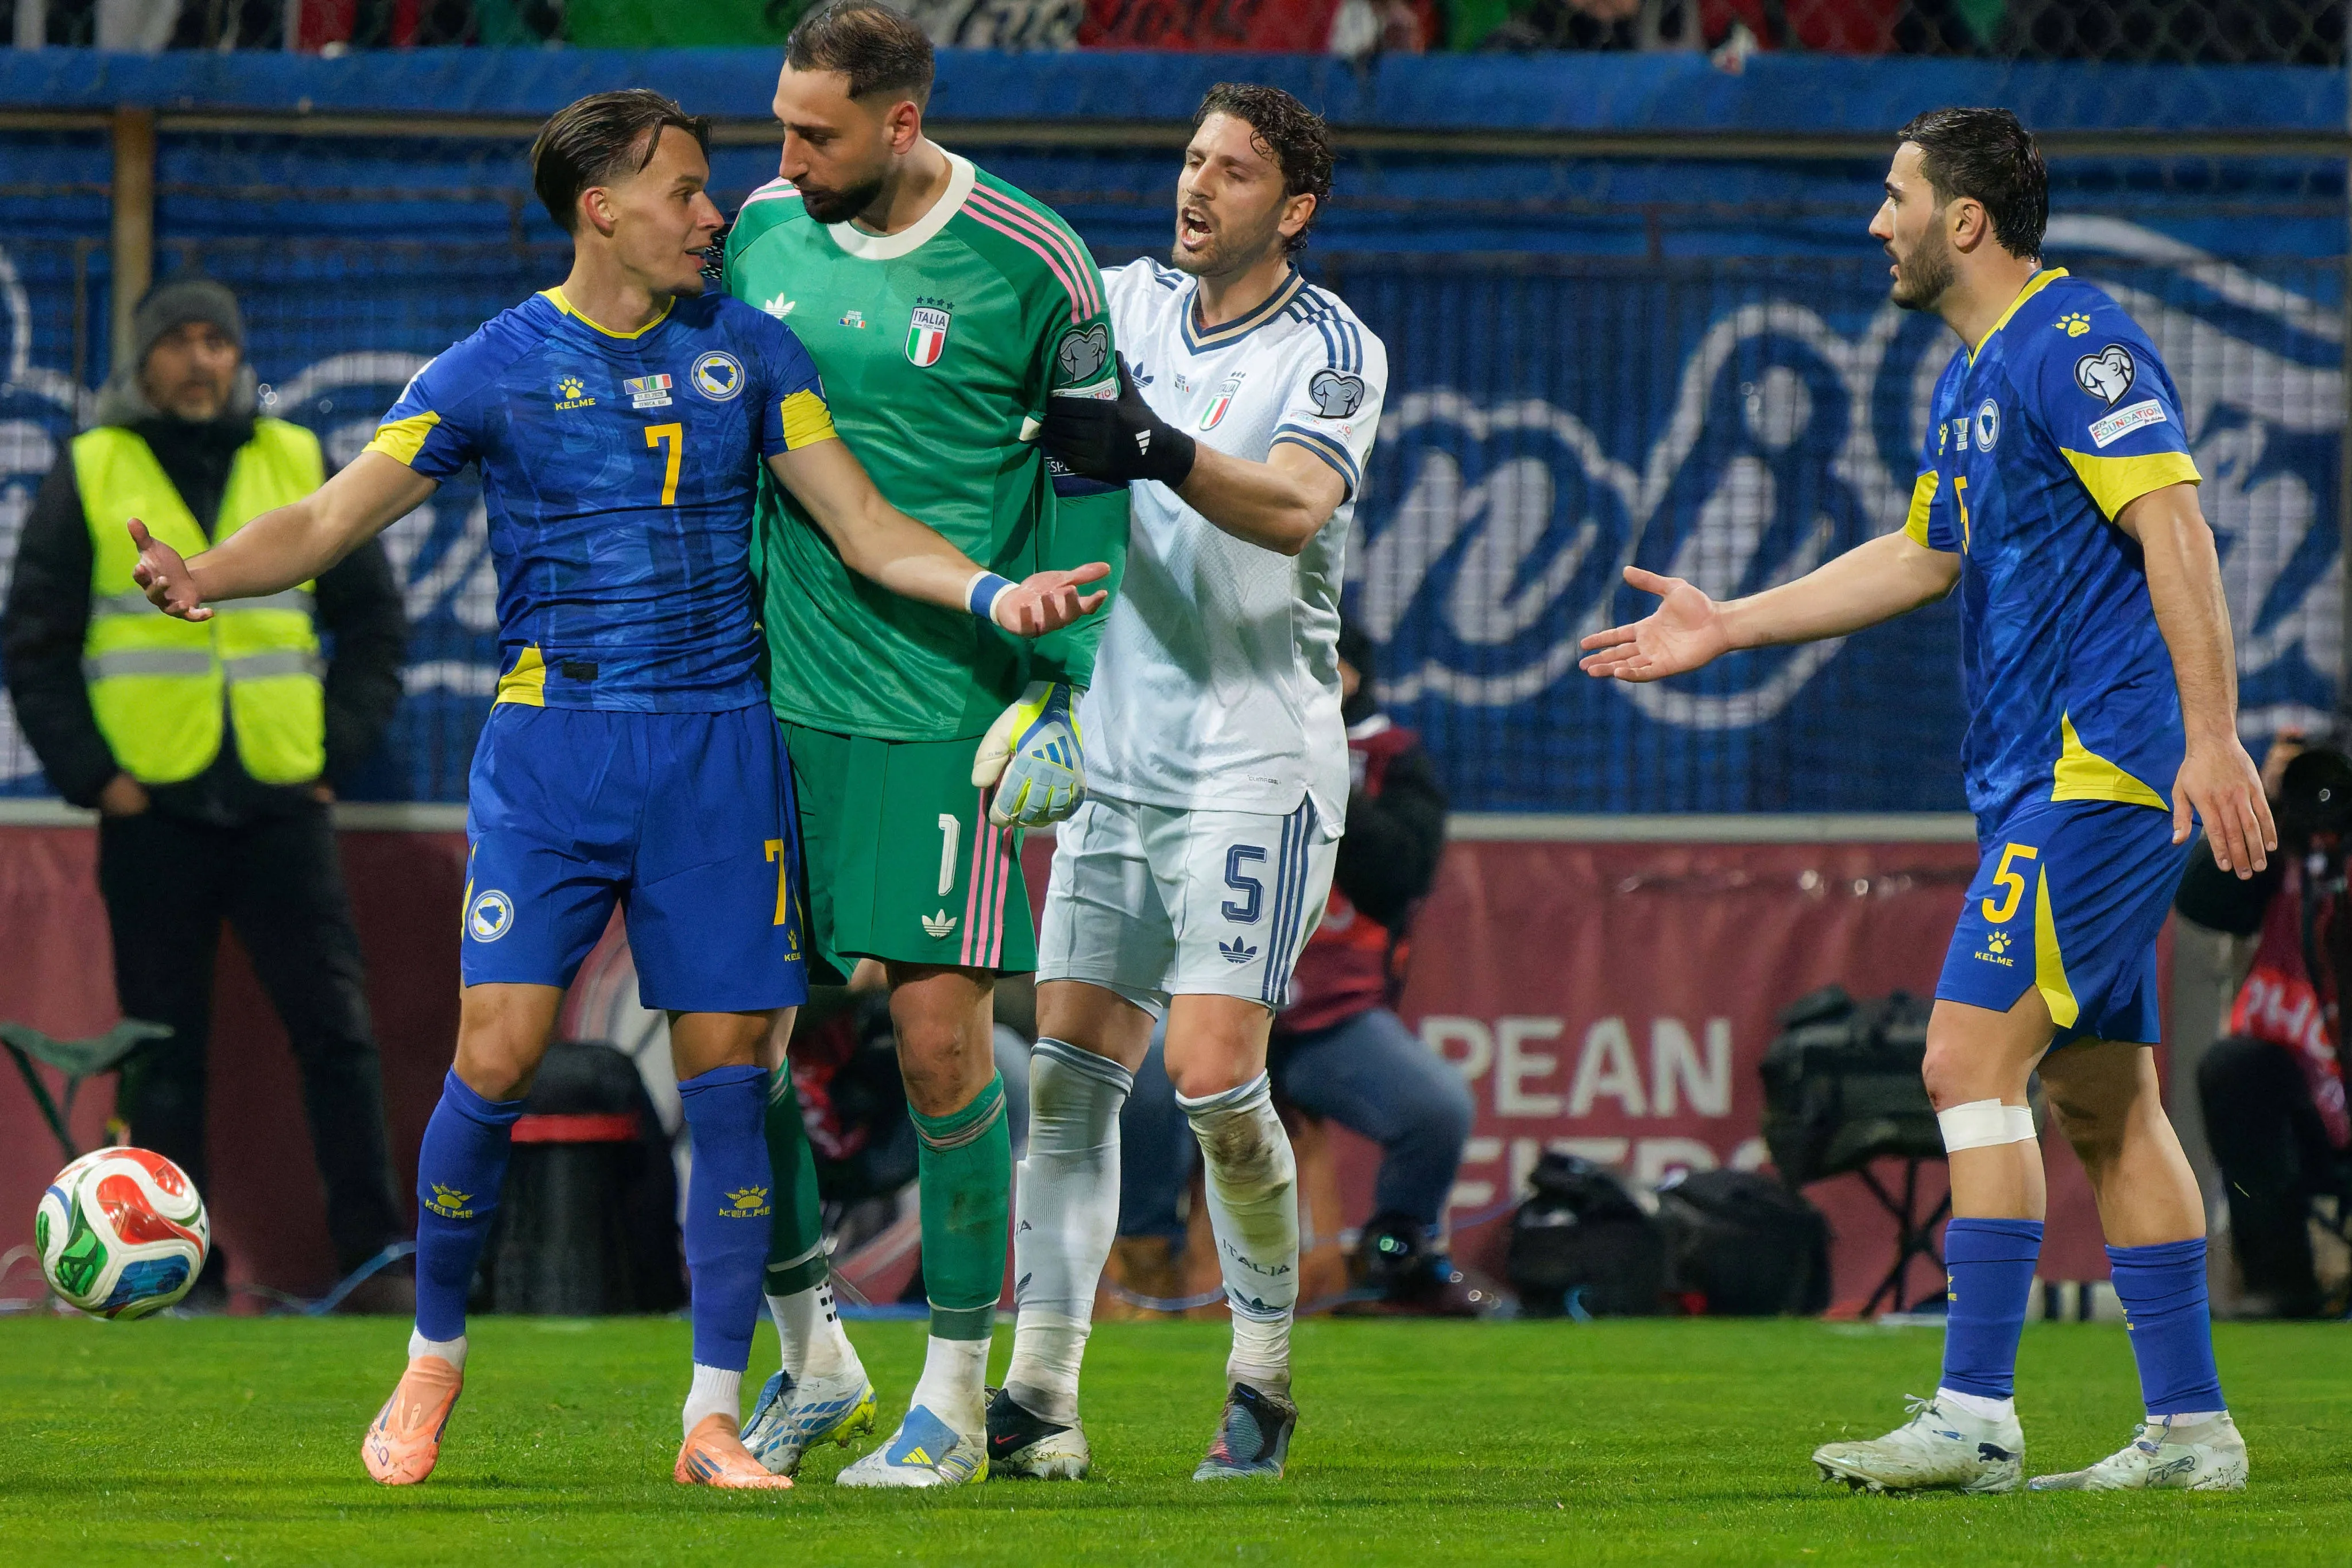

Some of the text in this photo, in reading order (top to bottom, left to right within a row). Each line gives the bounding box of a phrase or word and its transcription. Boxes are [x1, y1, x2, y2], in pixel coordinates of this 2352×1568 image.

[914, 311, 945, 327] ITALIA
[555, 398, 596, 411] KELME
[2094, 406, 2162, 440] FOUNDATION
[644, 423, 683, 505] 7
[938, 814, 961, 896] 1
[764, 838, 786, 926] 7
[1221, 844, 1267, 925] 5
[1982, 842, 2038, 924] 5
[1974, 951, 2014, 967] KELME
[425, 1198, 473, 1218] KELME
[1223, 1238, 1291, 1276] ITALIA
